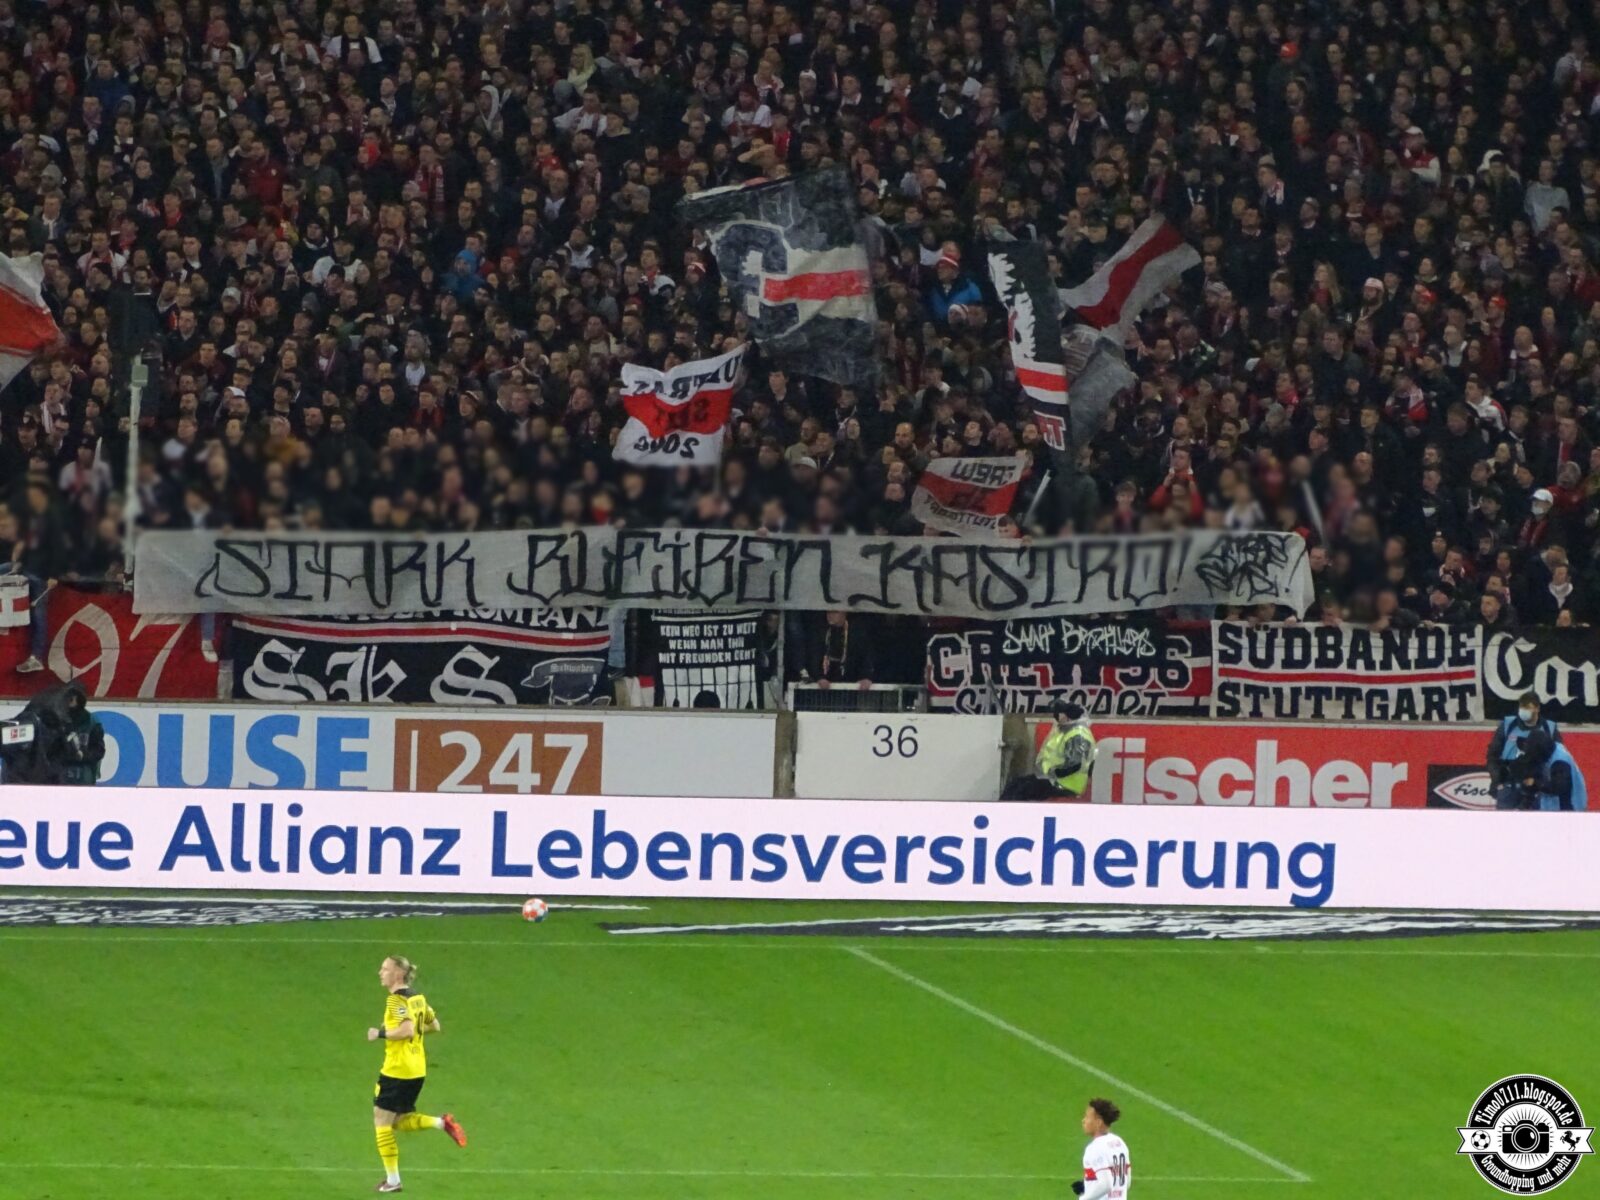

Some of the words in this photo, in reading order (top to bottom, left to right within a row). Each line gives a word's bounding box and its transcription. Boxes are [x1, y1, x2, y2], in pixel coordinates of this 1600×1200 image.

[194, 539, 484, 608] STARK
[847, 536, 1193, 614] KASTRO!
[47, 603, 194, 698] 97
[660, 625, 680, 636] KEIN
[703, 625, 719, 636] IST
[722, 624, 734, 636] ZU
[736, 622, 757, 635] WEIT
[668, 639, 697, 650] WENN
[700, 639, 724, 649] MAN
[728, 637, 744, 649] IHN
[1218, 622, 1476, 671] SÜDBANDE
[658, 652, 676, 663] MIT
[679, 652, 731, 664] FREUNDEN
[1216, 681, 1477, 721] STUTTGART
[439, 729, 589, 795] 247
[872, 725, 919, 758] 36
[1090, 737, 1408, 808] fischer
[159, 802, 461, 877] Allianz
[491, 808, 1336, 908] Lebensversicherung
